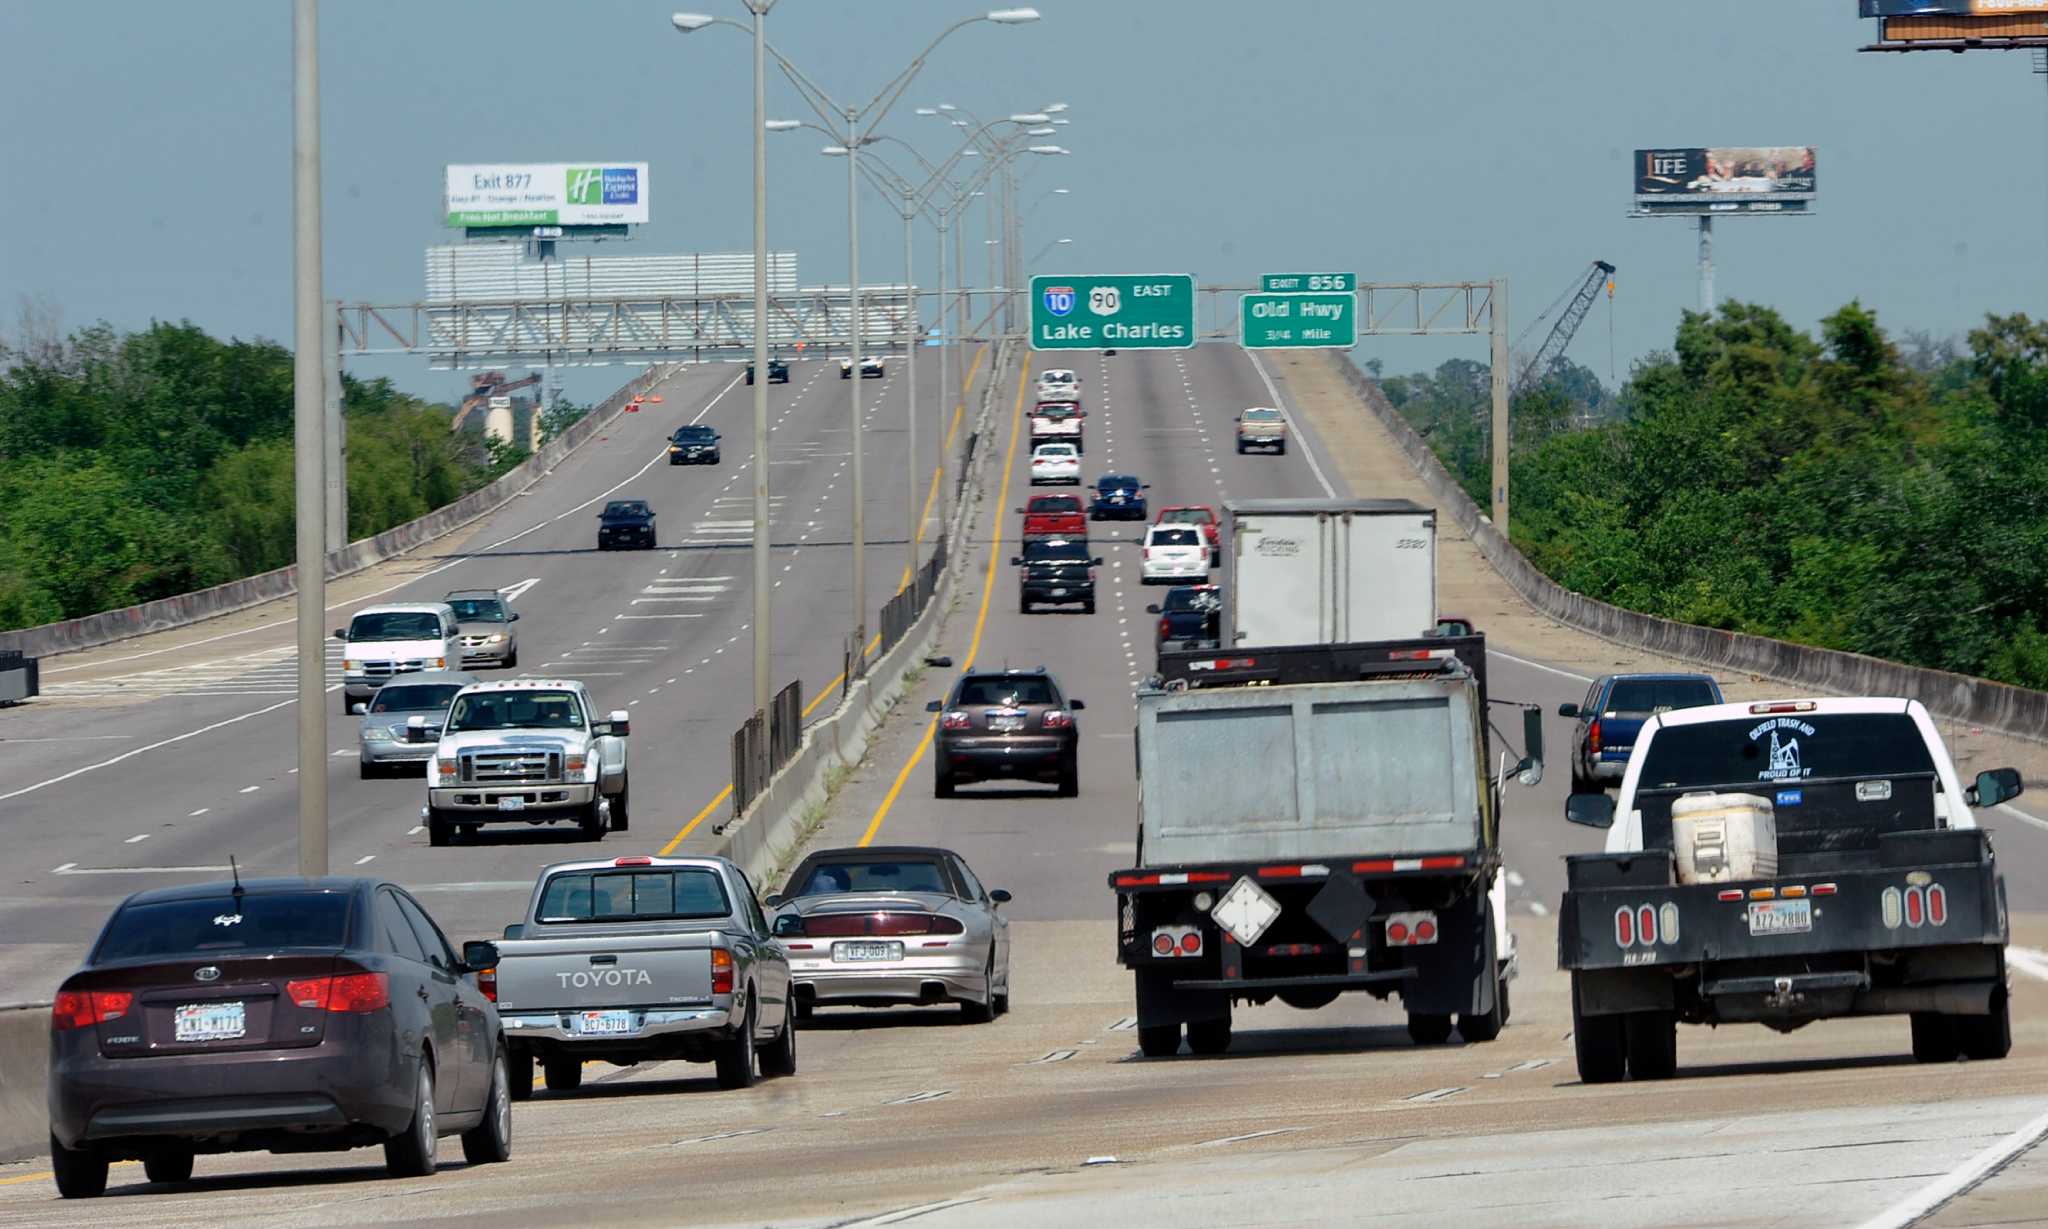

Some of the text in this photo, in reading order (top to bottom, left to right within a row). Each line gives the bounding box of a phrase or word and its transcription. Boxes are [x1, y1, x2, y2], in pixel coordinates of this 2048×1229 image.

[473, 173, 531, 189] Exit 877
[1133, 284, 1172, 297] EAST
[1269, 276, 1346, 290] EXIT 856
[1050, 294, 1070, 311] 10
[1092, 292, 1116, 308] 90
[1252, 301, 1343, 320] Old Hwy
[1042, 322, 1185, 340] Lake Charles
[1264, 328, 1332, 340] 3/4 Mile
[1749, 717, 1816, 740] OILFIELD TRASH AND
[1758, 768, 1812, 779] PROUD OF IT
[556, 969, 653, 989] TOYOTA
